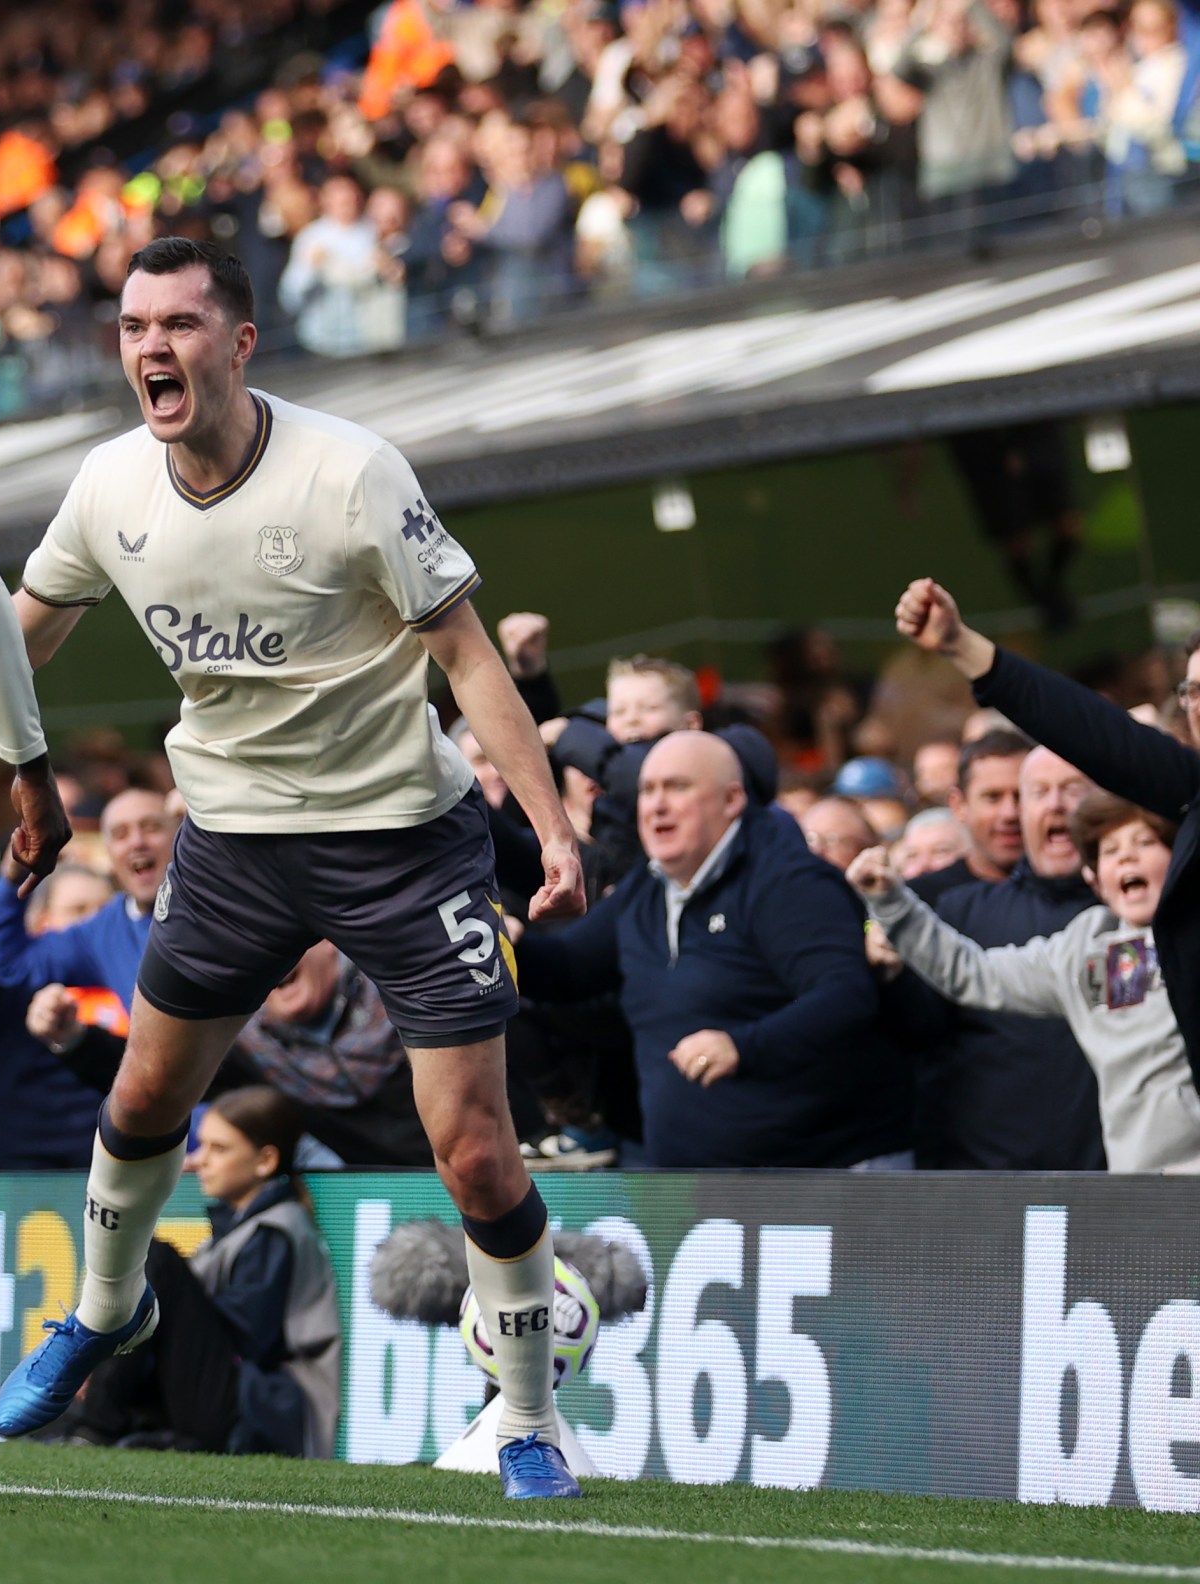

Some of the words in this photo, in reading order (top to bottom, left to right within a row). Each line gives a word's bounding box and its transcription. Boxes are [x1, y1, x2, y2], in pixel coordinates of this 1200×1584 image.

[145, 604, 288, 672] Stake
[204, 663, 233, 674] .com
[437, 889, 494, 964] 5
[86, 1193, 119, 1231] FC
[498, 1306, 549, 1338] EFC
